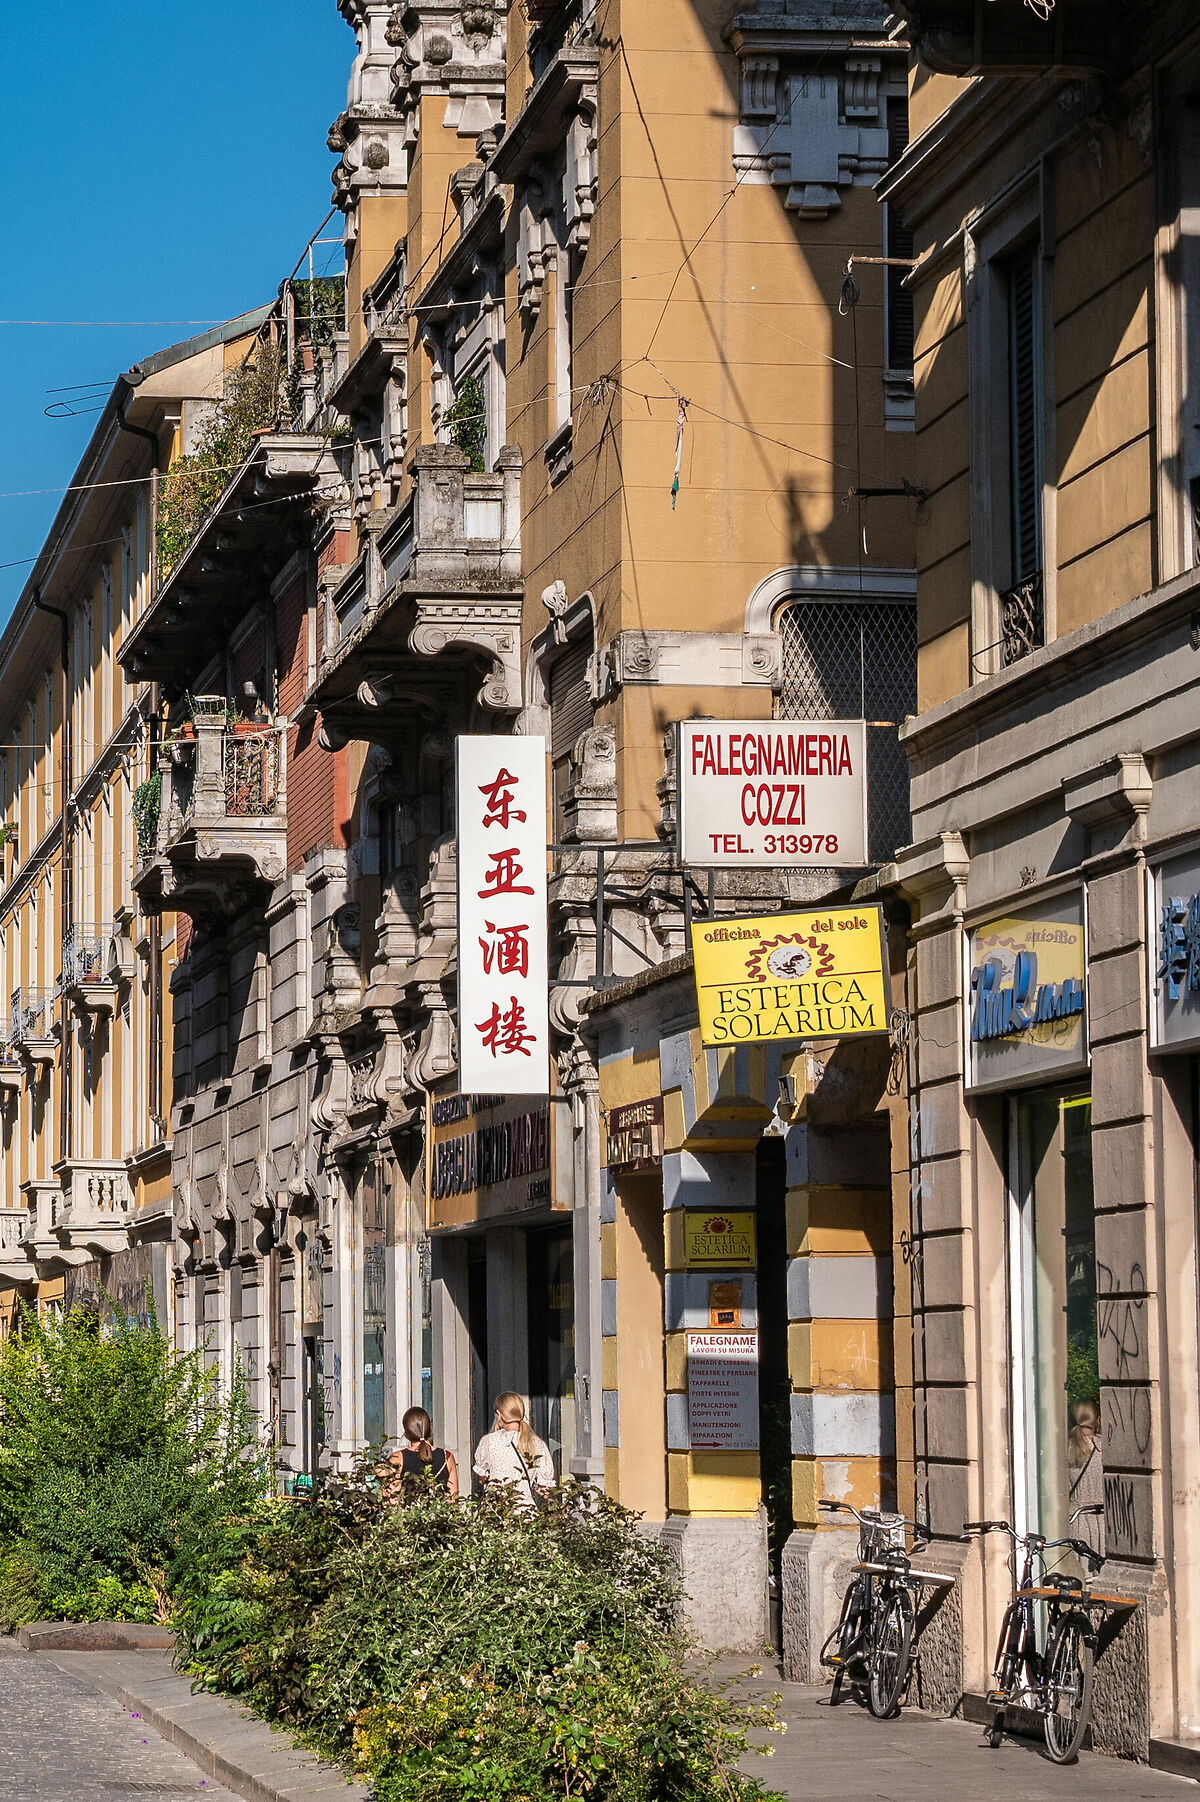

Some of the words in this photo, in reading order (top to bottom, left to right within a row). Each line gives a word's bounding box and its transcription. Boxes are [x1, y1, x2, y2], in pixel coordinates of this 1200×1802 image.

[691, 733, 853, 776] FALEGNAMERIA
[741, 783, 806, 827] COZZI
[709, 834, 754, 854] TEL.
[763, 834, 839, 854] 313978
[474, 767, 537, 1059] 东亚酒楼
[704, 926, 762, 943] officina
[810, 918, 834, 934] del
[837, 916, 869, 931] sole
[718, 979, 868, 1014] ESTETICA
[712, 1004, 877, 1041] SOLARIUM
[691, 1245, 751, 1255] SOLARIUM
[694, 1235, 748, 1245] ESTETICA
[690, 1336, 756, 1346] FALEGNAME
